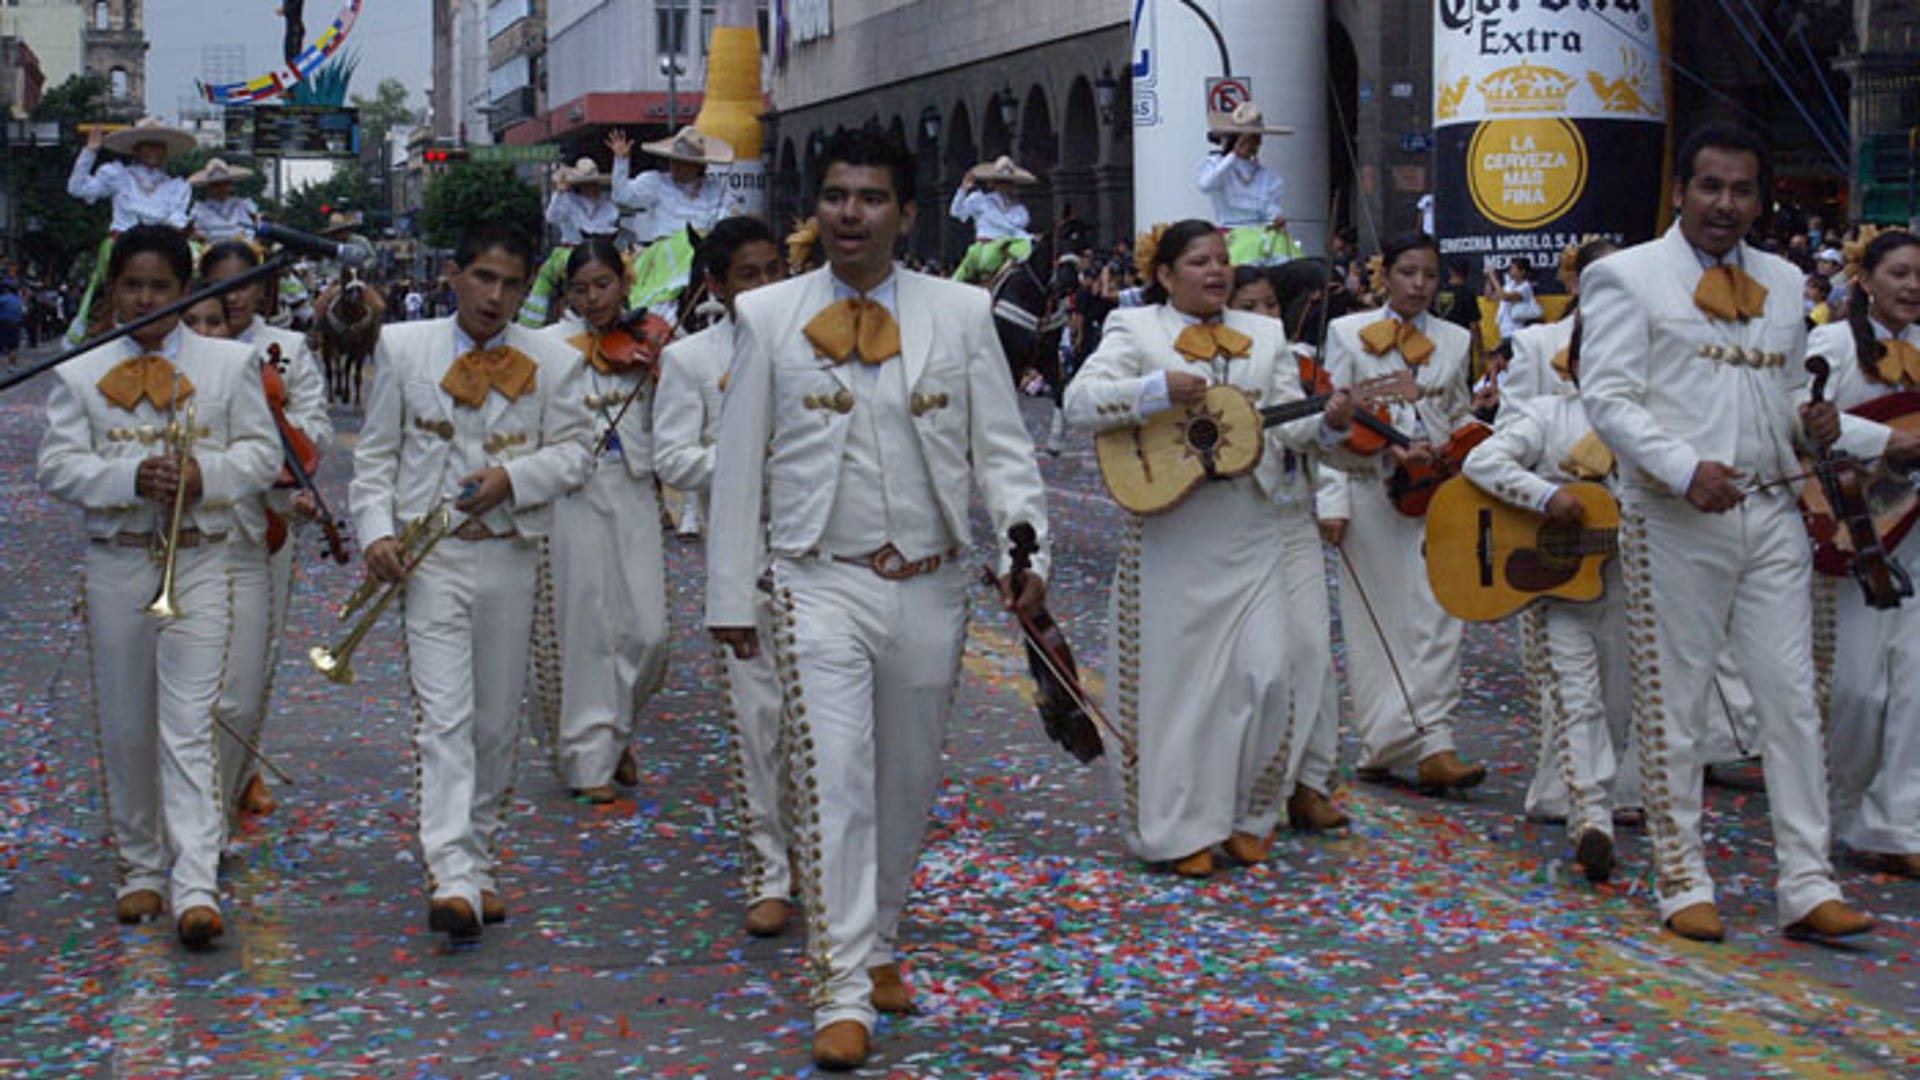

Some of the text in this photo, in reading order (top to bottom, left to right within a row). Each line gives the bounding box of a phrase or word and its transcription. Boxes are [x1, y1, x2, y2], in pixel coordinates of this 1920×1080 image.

[1479, 18, 1581, 55] Extra
[1510, 135, 1536, 151] LA
[1483, 152, 1567, 170] CERVEZA
[1503, 187, 1546, 205] FINA
